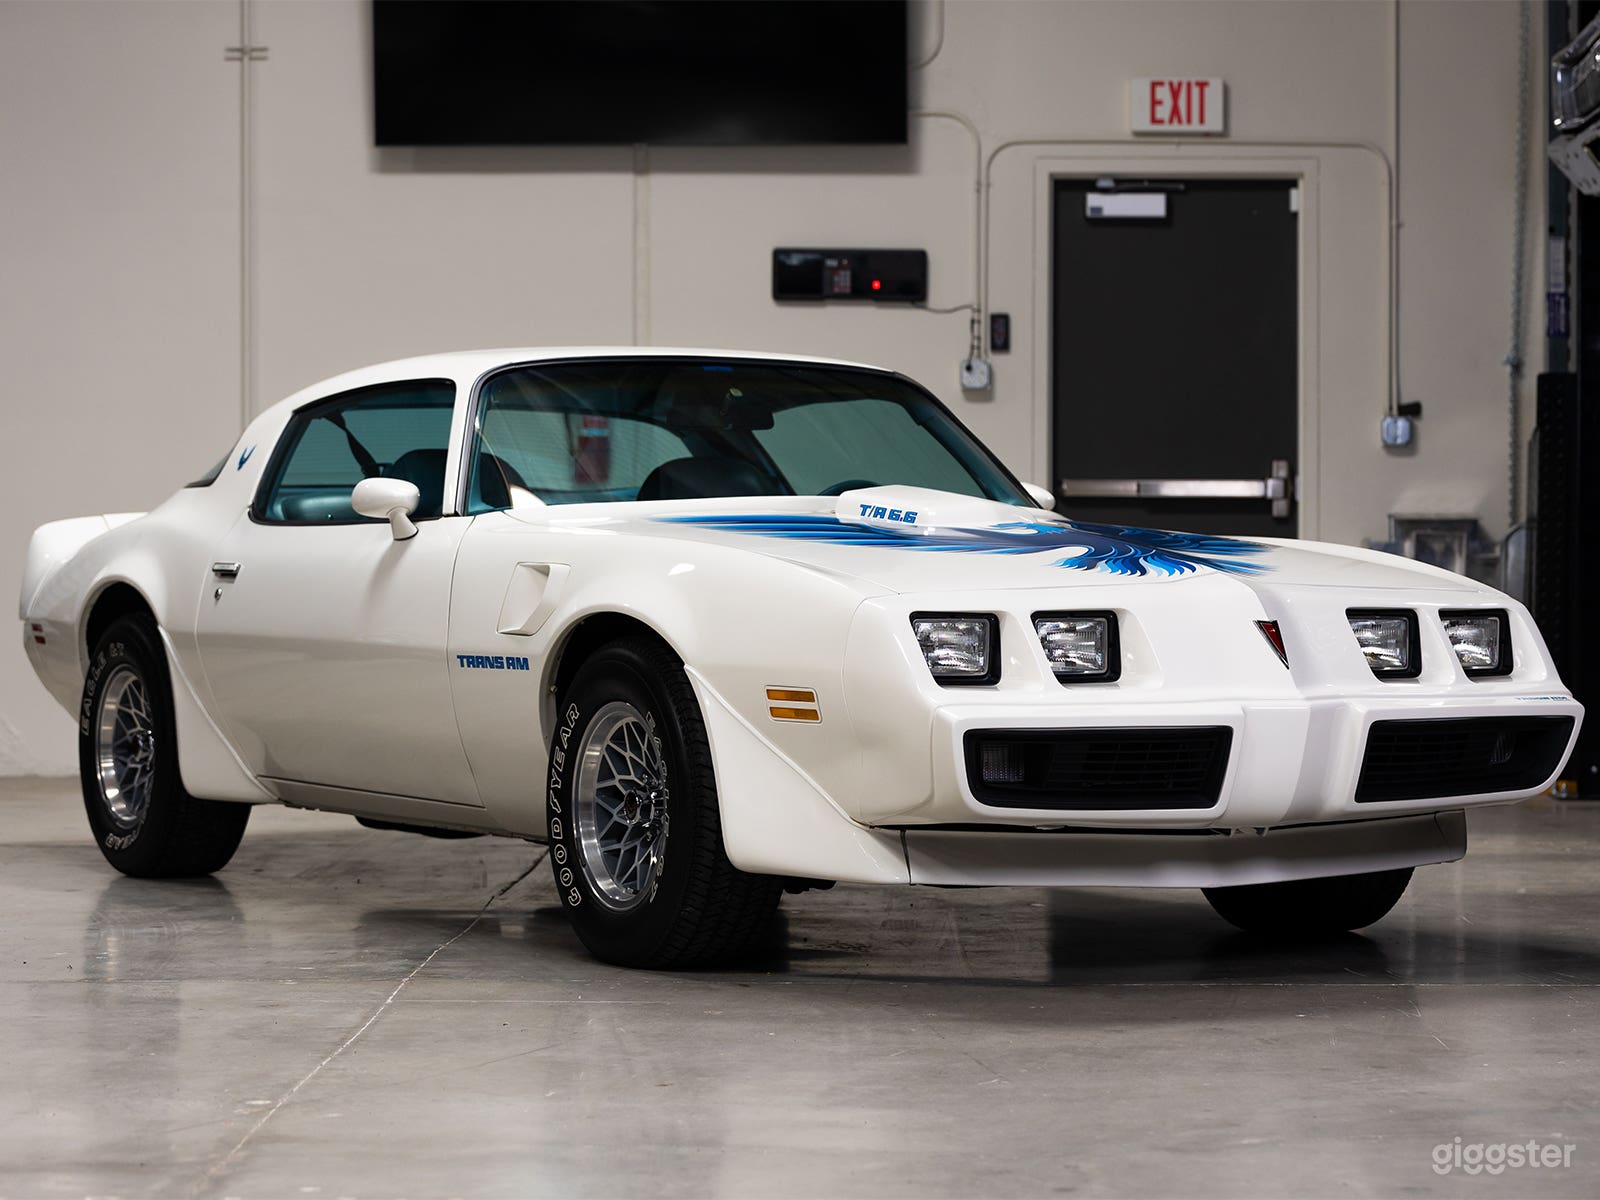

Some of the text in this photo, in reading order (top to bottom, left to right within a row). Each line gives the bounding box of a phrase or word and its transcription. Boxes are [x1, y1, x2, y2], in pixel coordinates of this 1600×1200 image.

[1149, 80, 1210, 125] EXIT
[860, 504, 918, 524] T/A 6.6
[456, 655, 530, 671] TRANS AM
[81, 651, 107, 736] EAGLE
[550, 703, 581, 906] GOODYEAR
